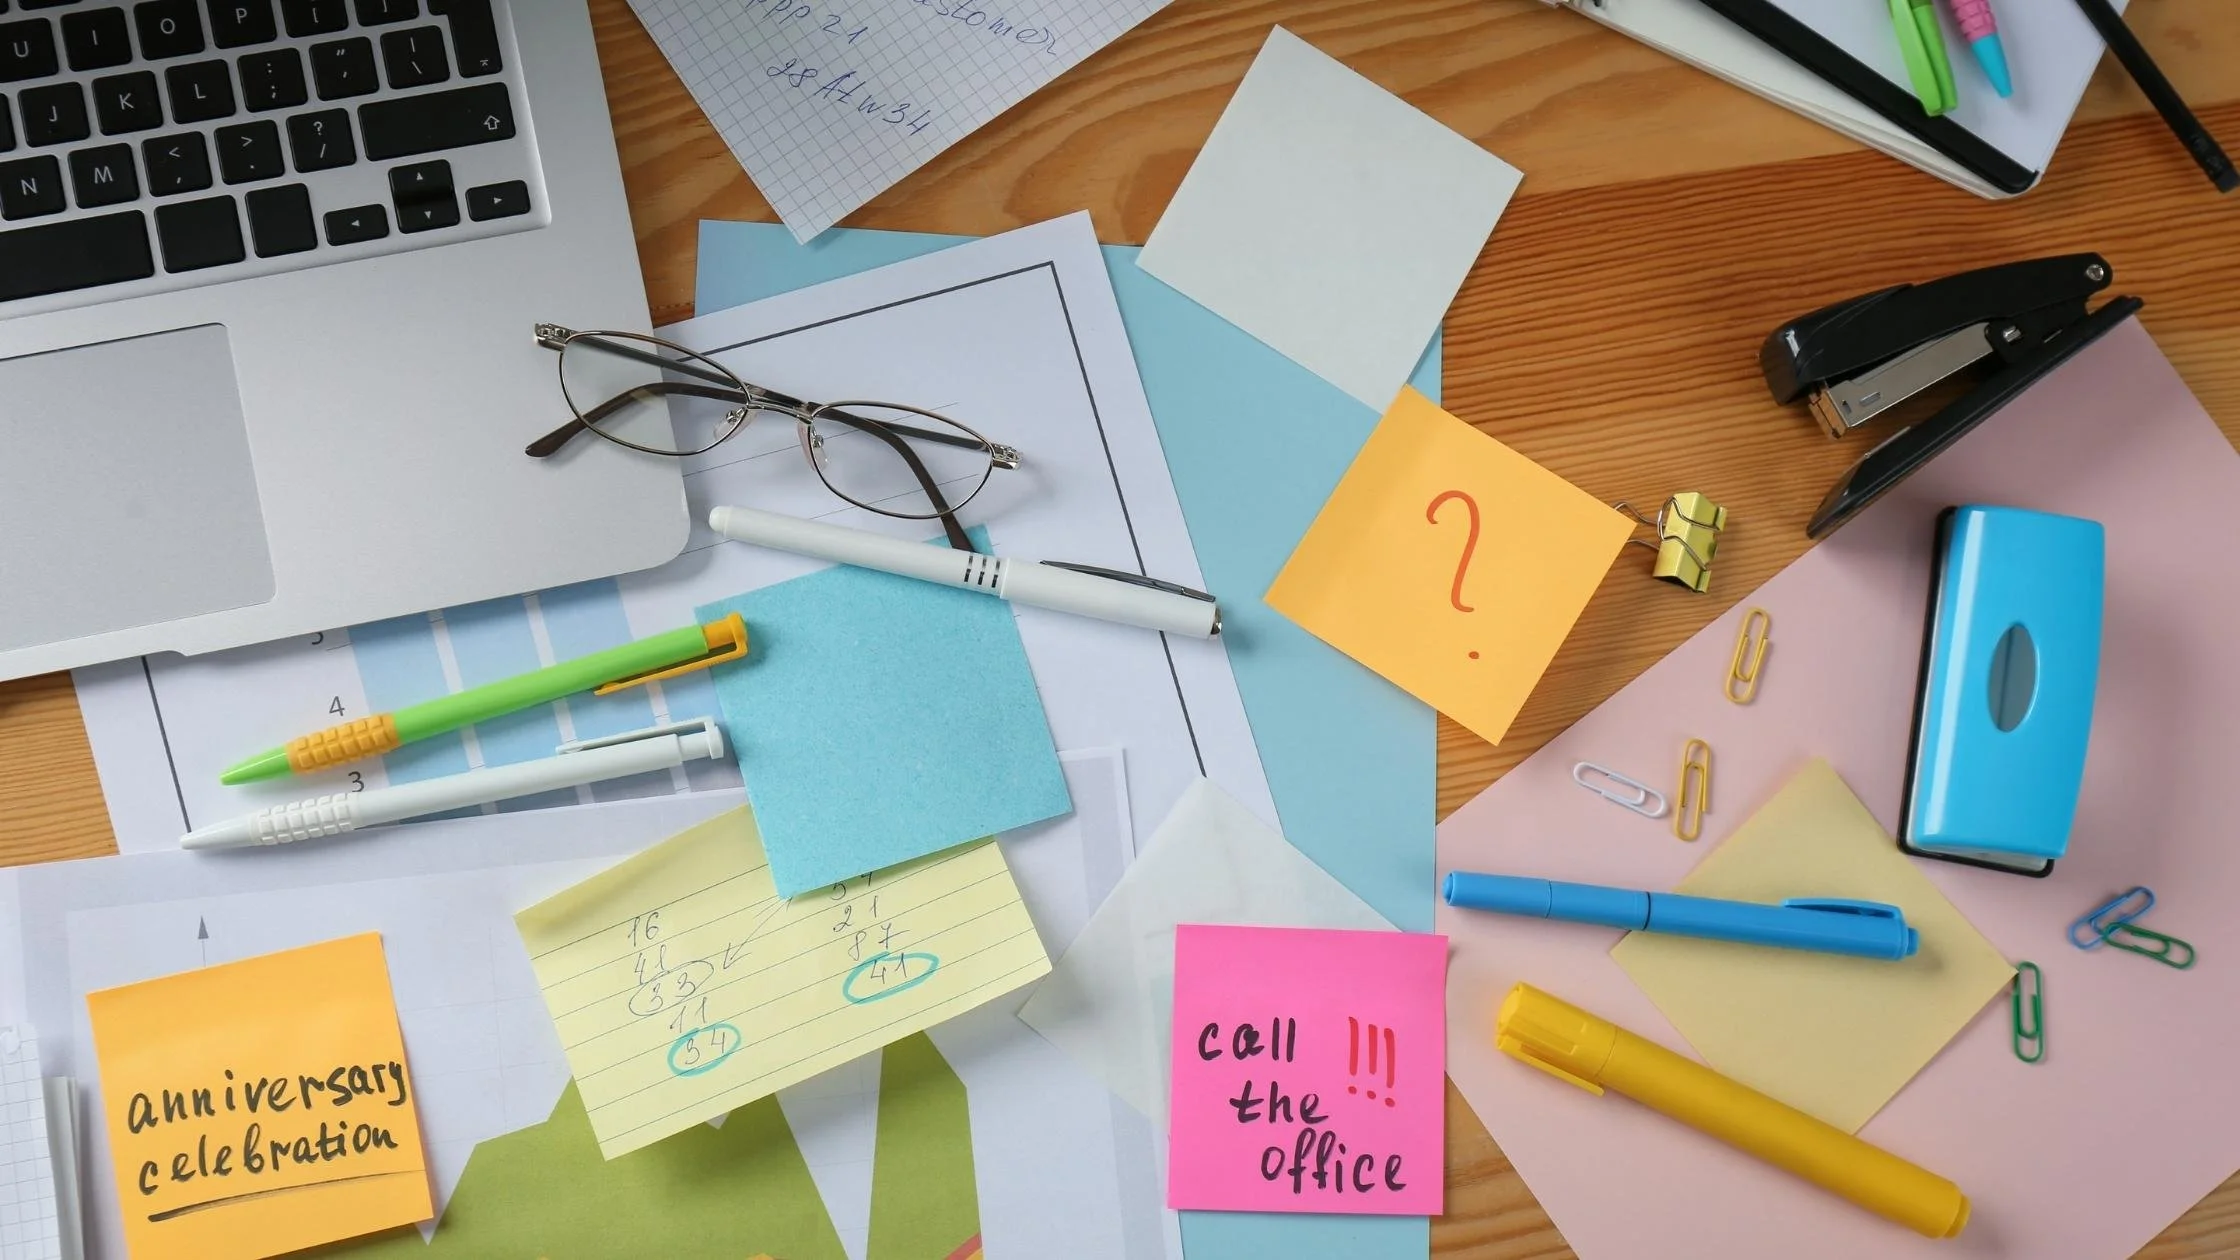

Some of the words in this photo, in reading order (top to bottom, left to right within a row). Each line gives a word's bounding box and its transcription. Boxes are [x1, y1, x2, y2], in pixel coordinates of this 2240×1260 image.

[160, 18, 176, 35] O
[235, 8, 248, 25] P
[92, 30, 98, 46] I
[12, 41, 29, 58] U
[119, 93, 135, 110] K
[194, 83, 207, 100] L
[49, 105, 58, 122] J
[94, 166, 114, 185] M
[21, 178, 39, 196] N
[1426, 490, 1481, 660] ?
[328, 695, 346, 717] 4
[347, 771, 365, 793] 3
[832, 895, 879, 932] 21
[627, 911, 660, 947] 16
[870, 952, 907, 984] 41
[644, 970, 697, 1014] 33
[1198, 1016, 1296, 1062] call
[127, 1060, 408, 1135] anniversary
[1229, 1079, 1329, 1124] the
[138, 1122, 399, 1196] celebration
[1260, 1126, 1407, 1195] office
